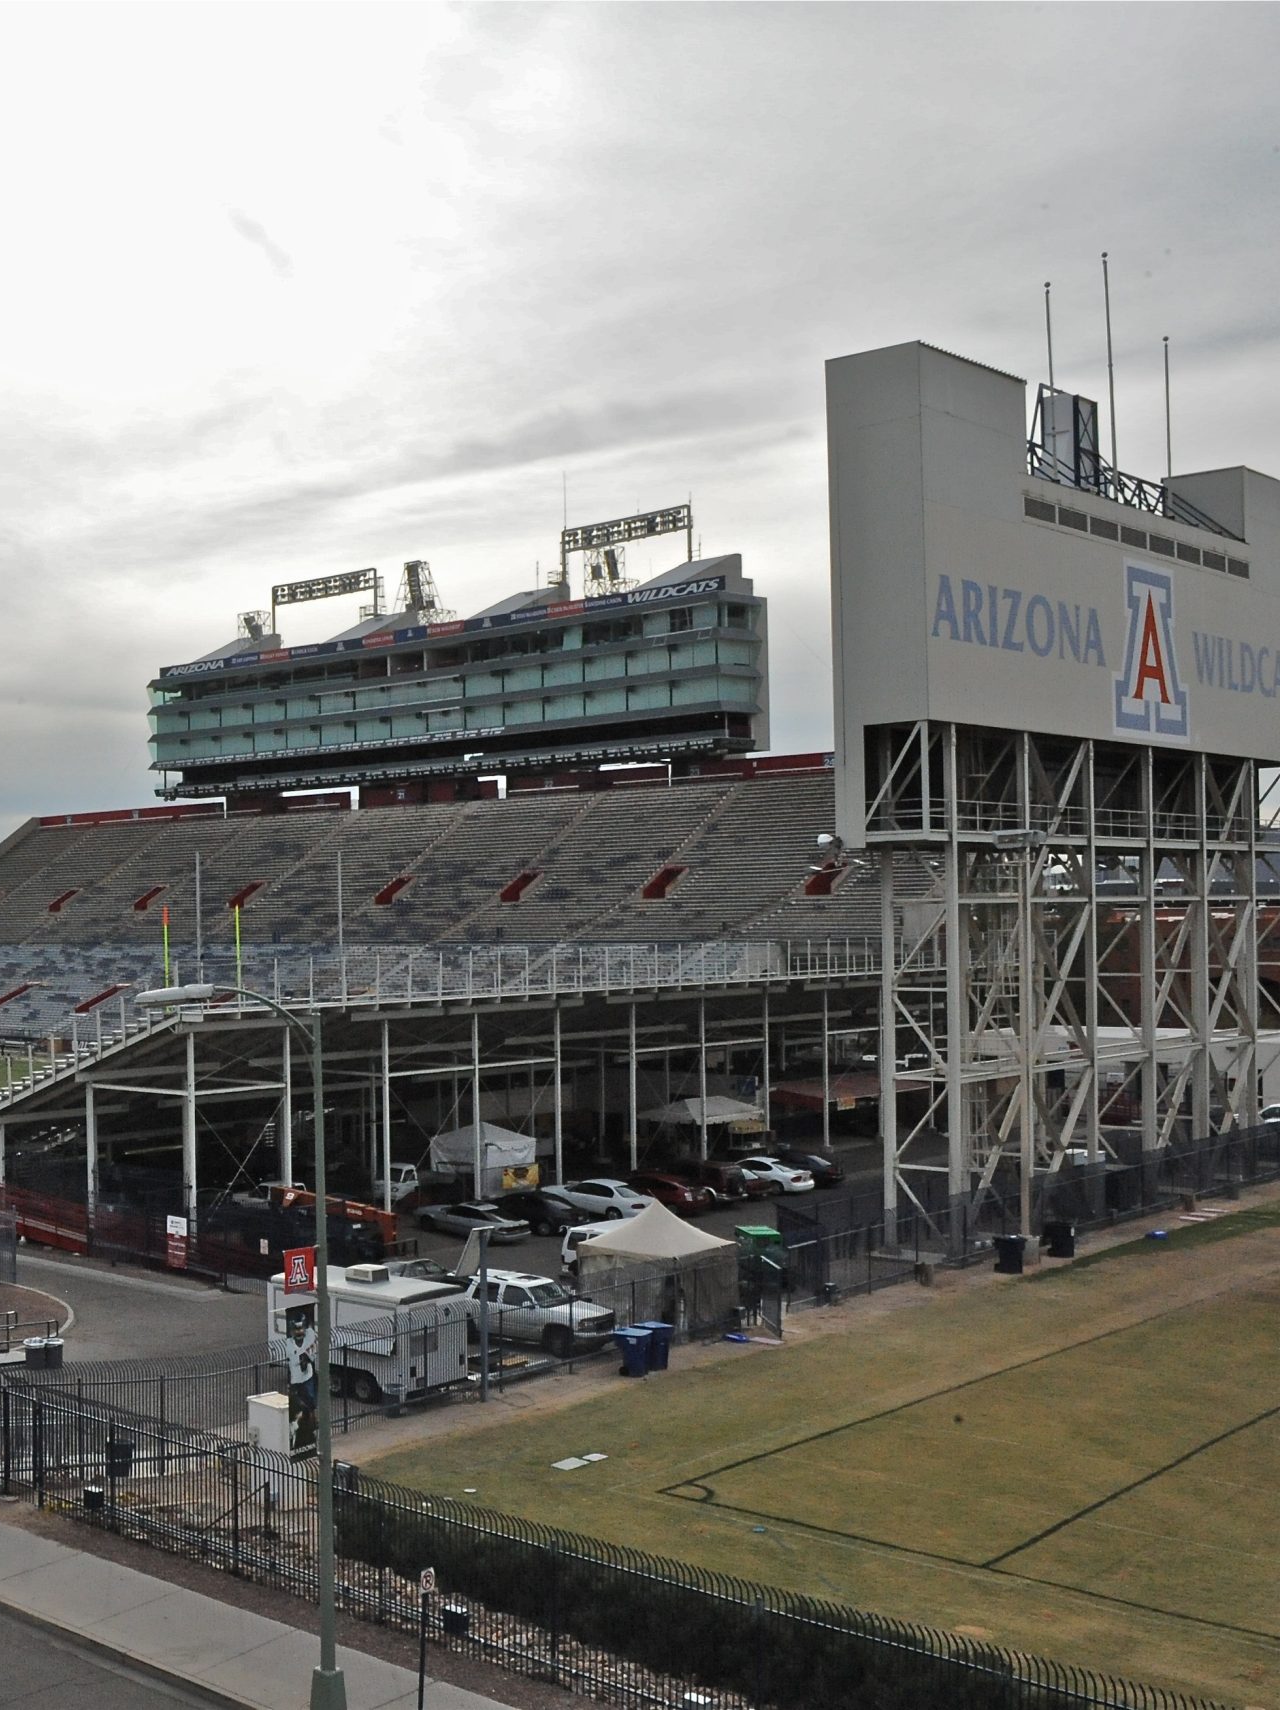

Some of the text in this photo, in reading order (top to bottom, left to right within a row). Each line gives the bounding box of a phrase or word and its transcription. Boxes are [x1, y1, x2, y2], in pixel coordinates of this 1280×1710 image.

[627, 578, 720, 604] WILDCATS
[931, 574, 1107, 668] ARIZONA
[1112, 557, 1191, 744] A
[166, 660, 224, 676] ARIZONA
[288, 1255, 309, 1286] A
